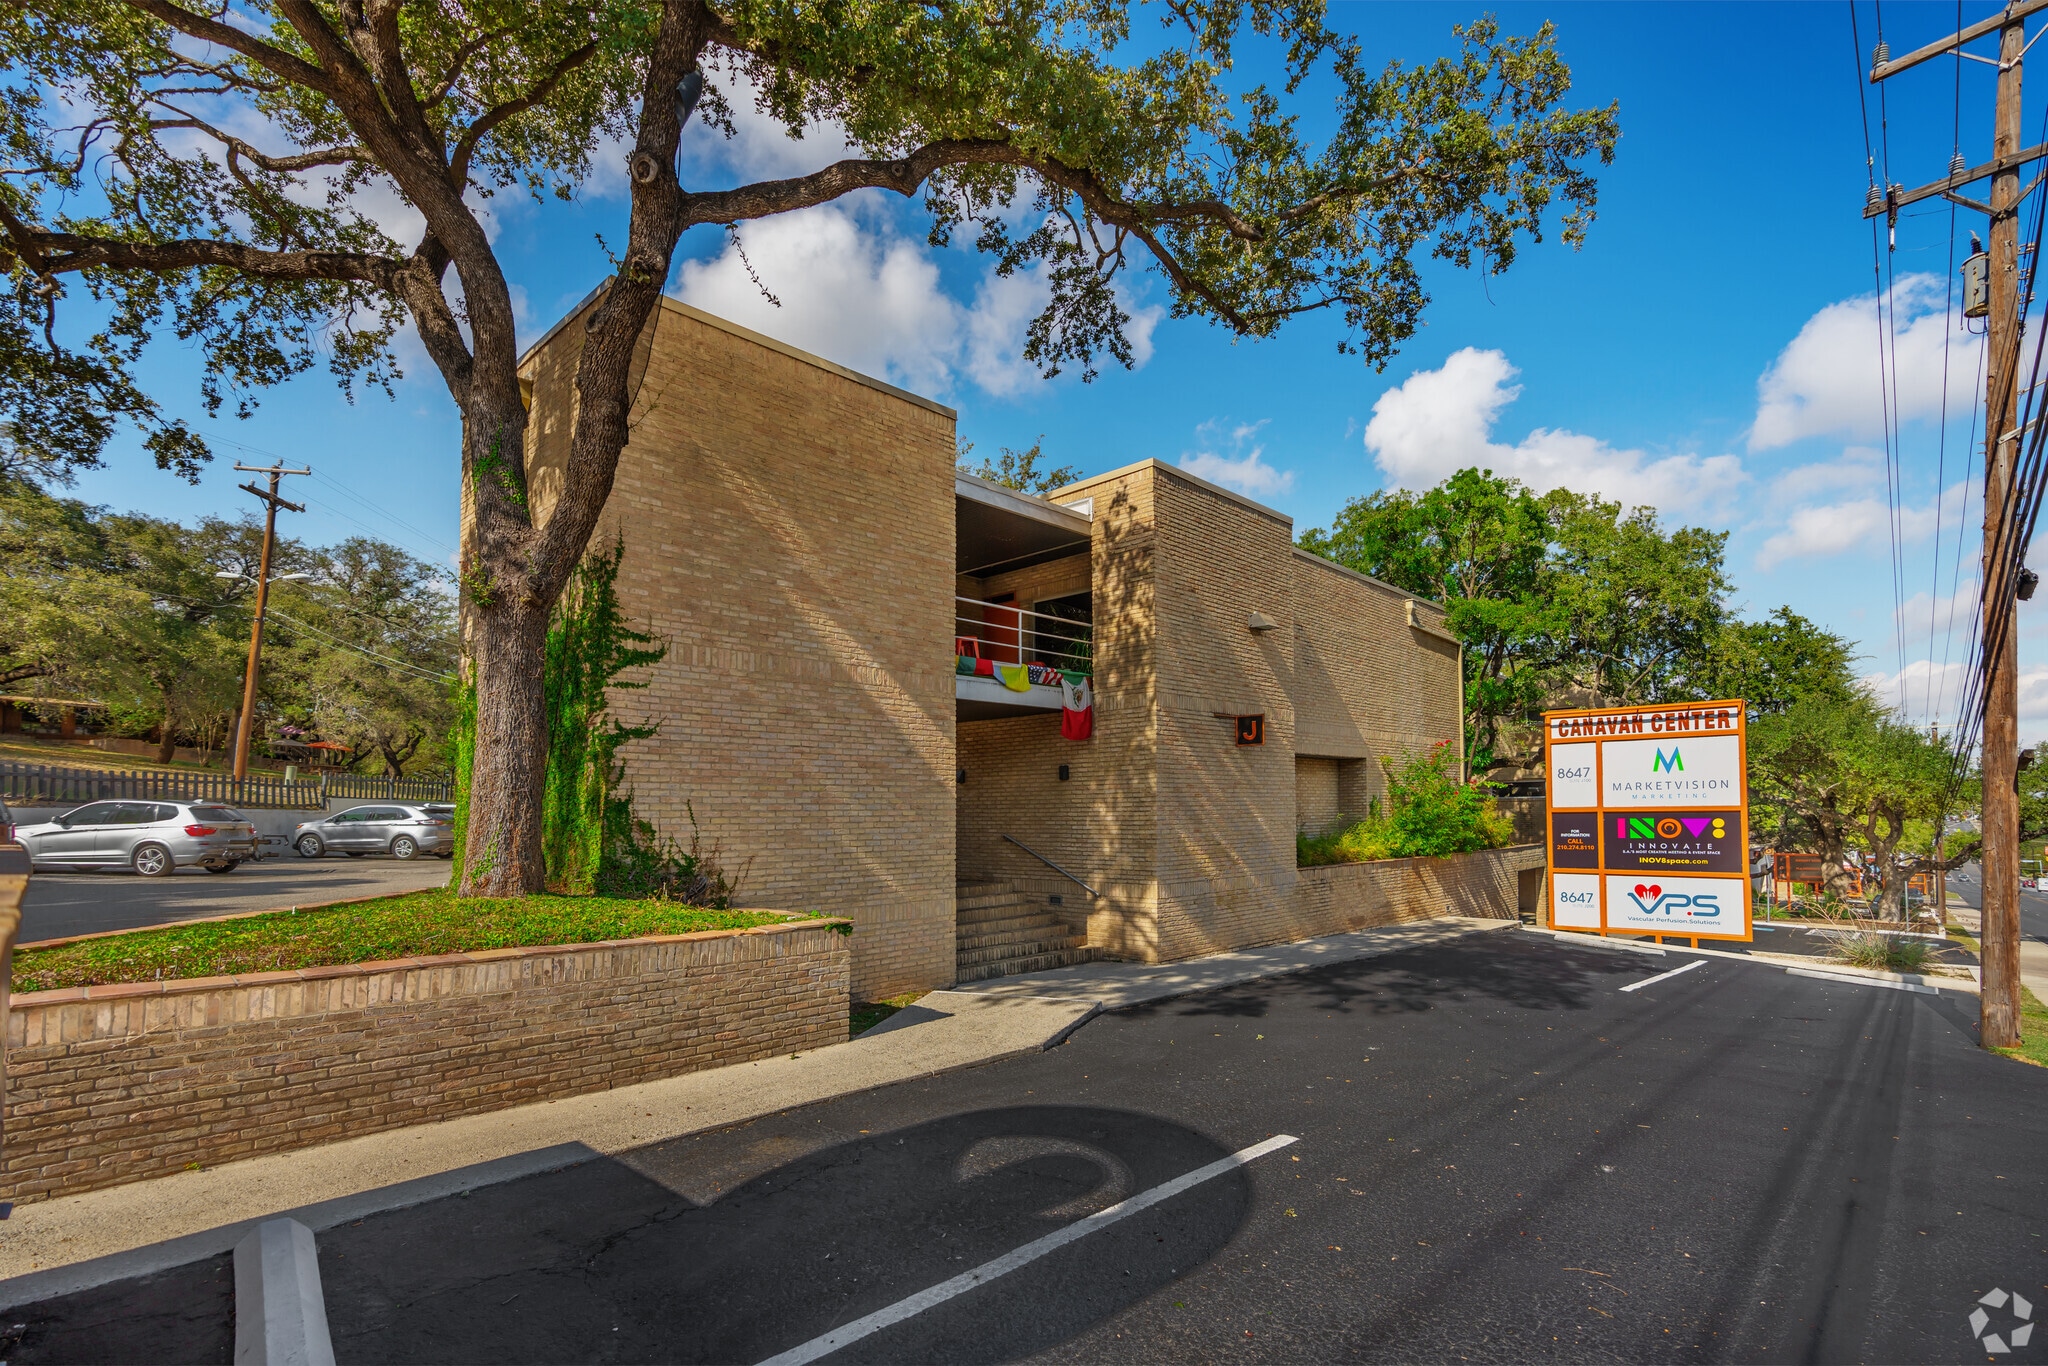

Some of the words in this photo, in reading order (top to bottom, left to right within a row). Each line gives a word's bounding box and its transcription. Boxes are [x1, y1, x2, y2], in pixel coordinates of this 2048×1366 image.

[1558, 715, 1643, 738] CANAVAN
[1651, 709, 1731, 732] CENTER
[1242, 720, 1257, 741] J
[1557, 767, 1591, 779] 8647
[1612, 779, 1730, 791] MARKETVISION
[1629, 842, 1713, 850] INNOVATE
[1639, 857, 1709, 865] INOV8space.com
[1560, 892, 1594, 903] 8647
